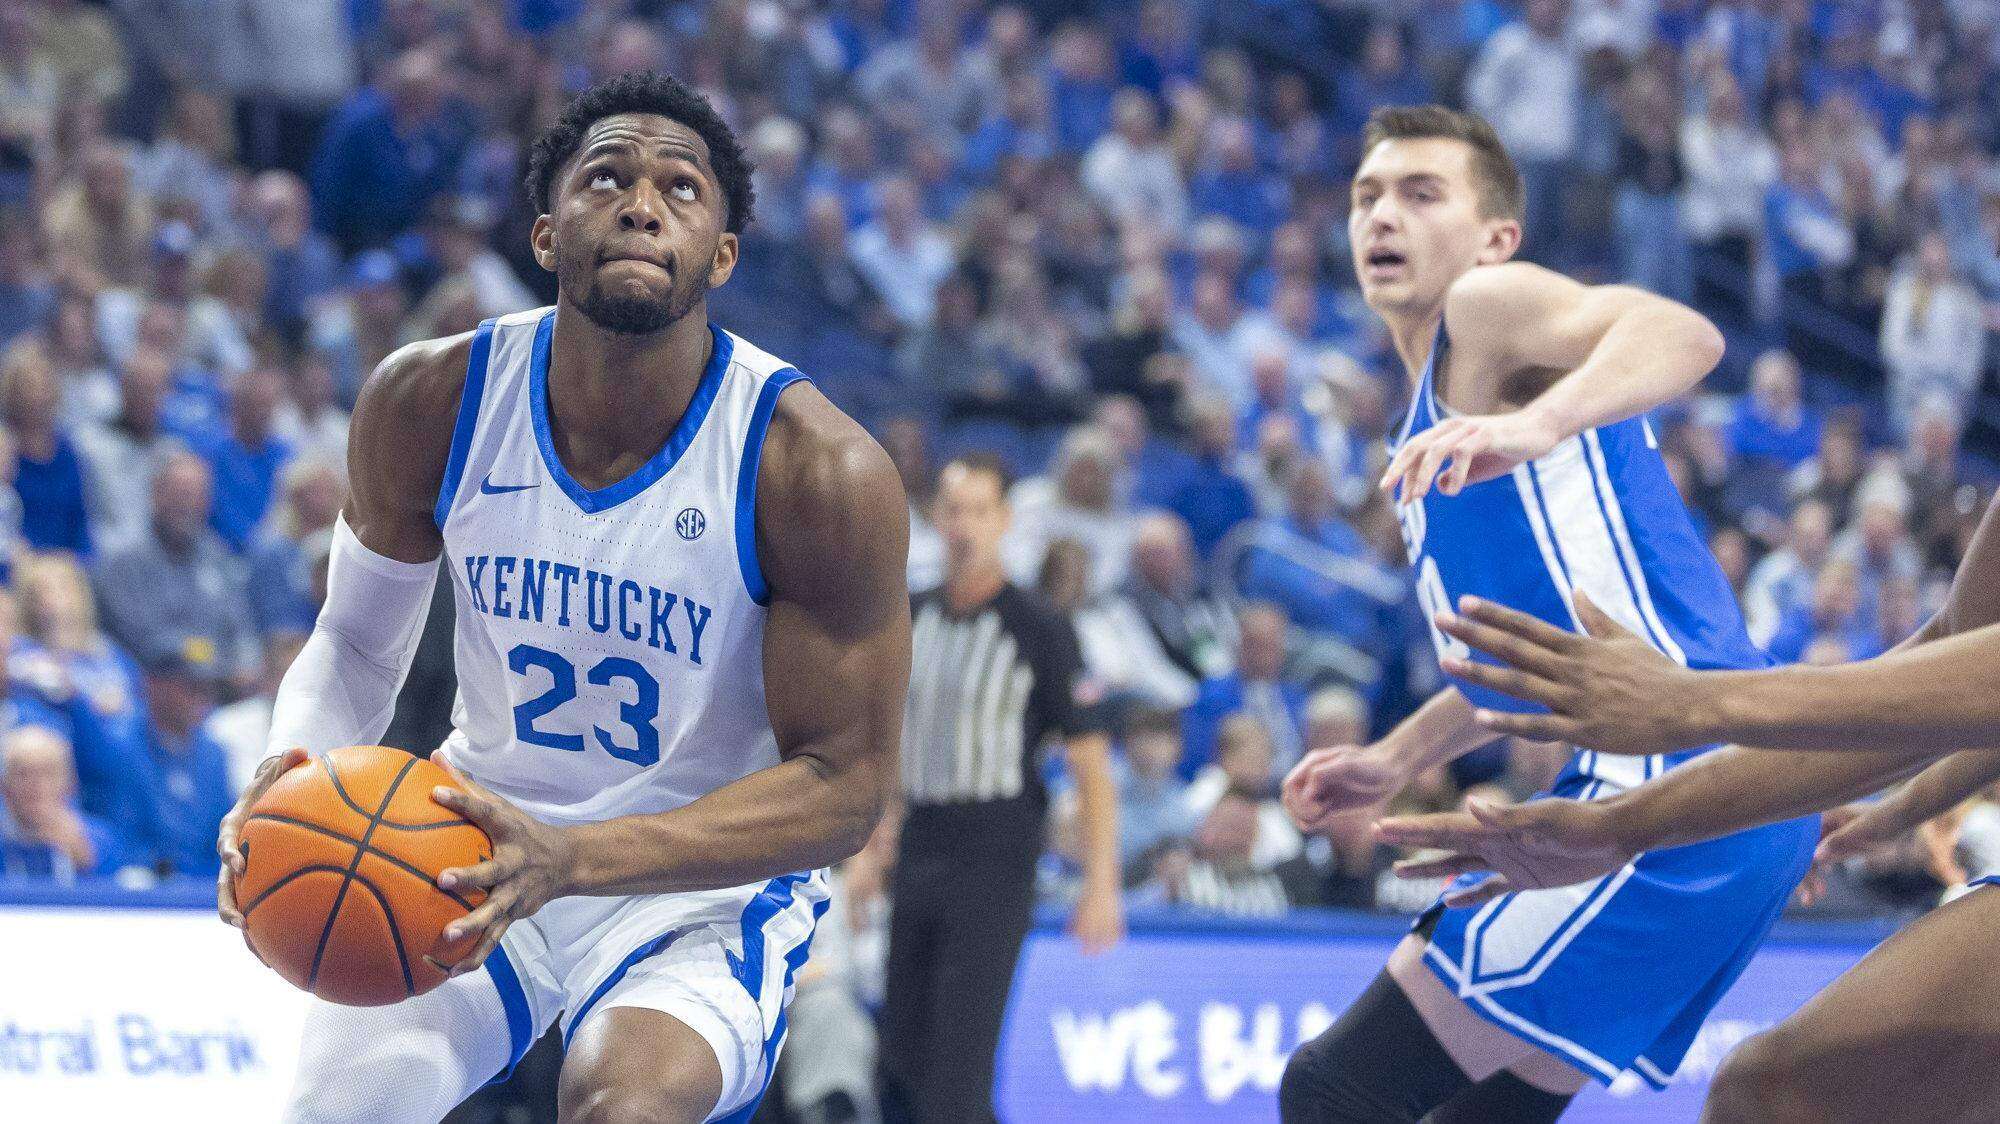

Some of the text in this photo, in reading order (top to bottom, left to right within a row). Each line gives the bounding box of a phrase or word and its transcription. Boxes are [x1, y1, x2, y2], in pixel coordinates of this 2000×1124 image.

[676, 508, 706, 540] SEC
[465, 555, 712, 665] KENTUCKY
[507, 643, 660, 768] 23
[113, 1012, 264, 1077] Bank
[1052, 1000, 1184, 1097] WE
